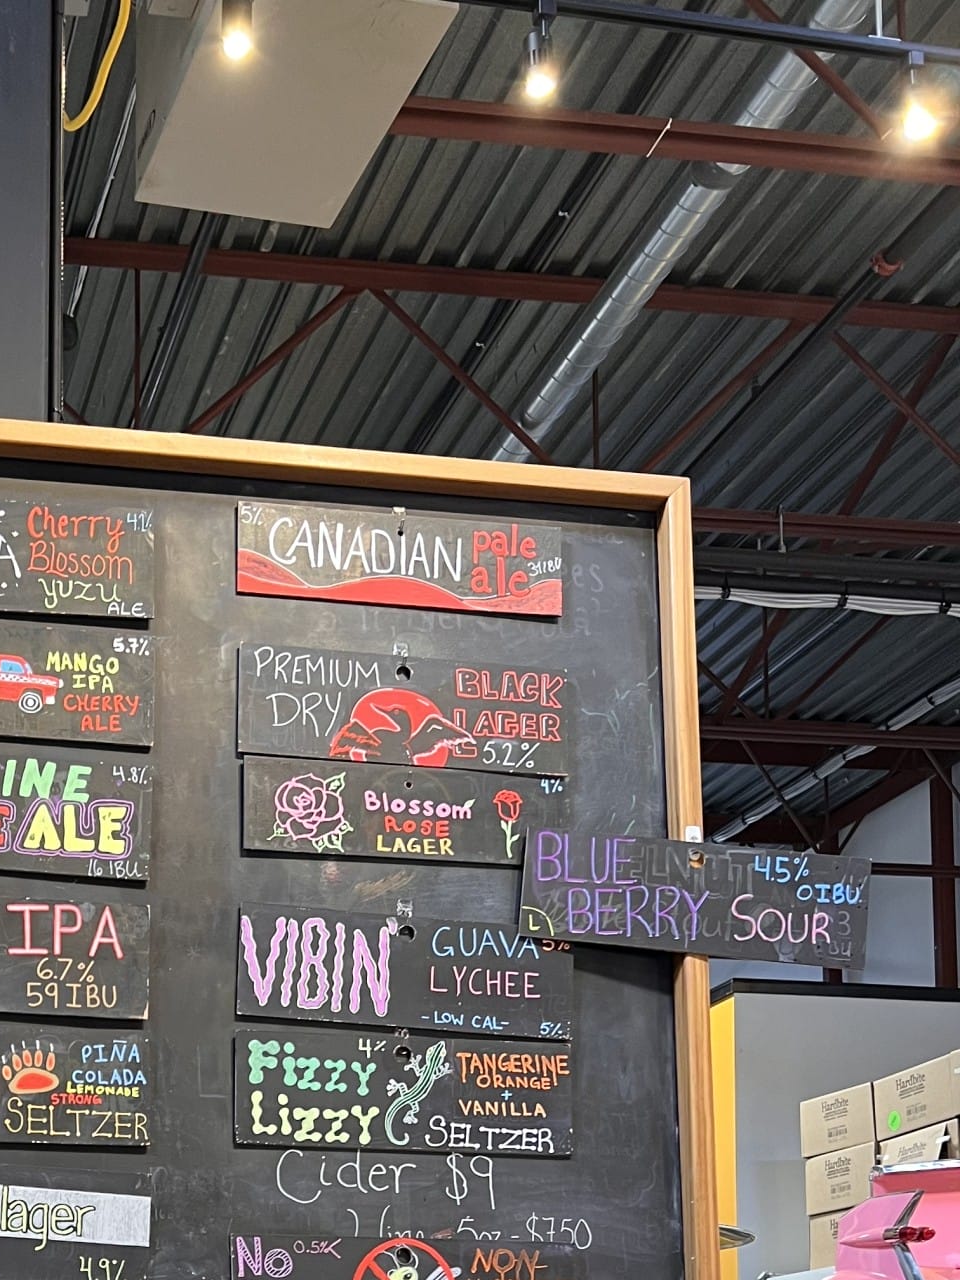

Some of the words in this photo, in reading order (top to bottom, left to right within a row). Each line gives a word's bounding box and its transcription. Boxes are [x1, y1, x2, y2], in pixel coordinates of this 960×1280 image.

[240, 505, 263, 526] 5%
[27, 507, 125, 553] Cherry
[268, 518, 462, 582] CANADIAN
[473, 523, 537, 565] pale
[470, 556, 532, 598] ale
[107, 602, 144, 616] ALE
[113, 638, 150, 656] 5.7%
[45, 651, 120, 676] MANGO
[254, 647, 381, 688] PREMIUM
[72, 675, 114, 693] IPA
[455, 668, 564, 709] BLACK
[63, 695, 140, 716] CHERRY
[266, 692, 341, 737] DRY
[81, 715, 122, 732] ALE
[453, 708, 563, 752] LAGER
[482, 743, 539, 768] 5.2%
[112, 765, 149, 784] 4.8%
[540, 779, 563, 794] 4%
[21, 804, 128, 854] ALE
[376, 836, 454, 856] LAGER
[536, 831, 638, 884] BLUE
[755, 856, 809, 882] 4.5%
[568, 886, 709, 941] BERRY
[731, 894, 830, 944] SOUR
[6, 903, 124, 960] IPA
[432, 927, 540, 959] GUAVA
[36, 958, 95, 982] 6.7%
[430, 967, 541, 999] LYCHEE
[540, 1022, 563, 1035] 5%
[81, 1040, 141, 1064] PIÑA
[358, 1039, 386, 1058] 4%
[72, 1069, 147, 1086] COLADA
[456, 1052, 570, 1086] TANGERINE
[66, 1083, 140, 1098] LEMONADE
[476, 1075, 551, 1090] ORANGE
[896, 1073, 925, 1091] Hardbite
[51, 1093, 103, 1106] STRONG
[459, 1100, 546, 1118] VANILLA
[821, 1098, 848, 1112] Hardbite
[4, 1097, 150, 1141] SELTZER
[425, 1116, 555, 1153] SELTZER
[276, 1149, 417, 1204] Cider
[446, 1153, 496, 1210] $9
[0, 1185, 95, 1250] lager
